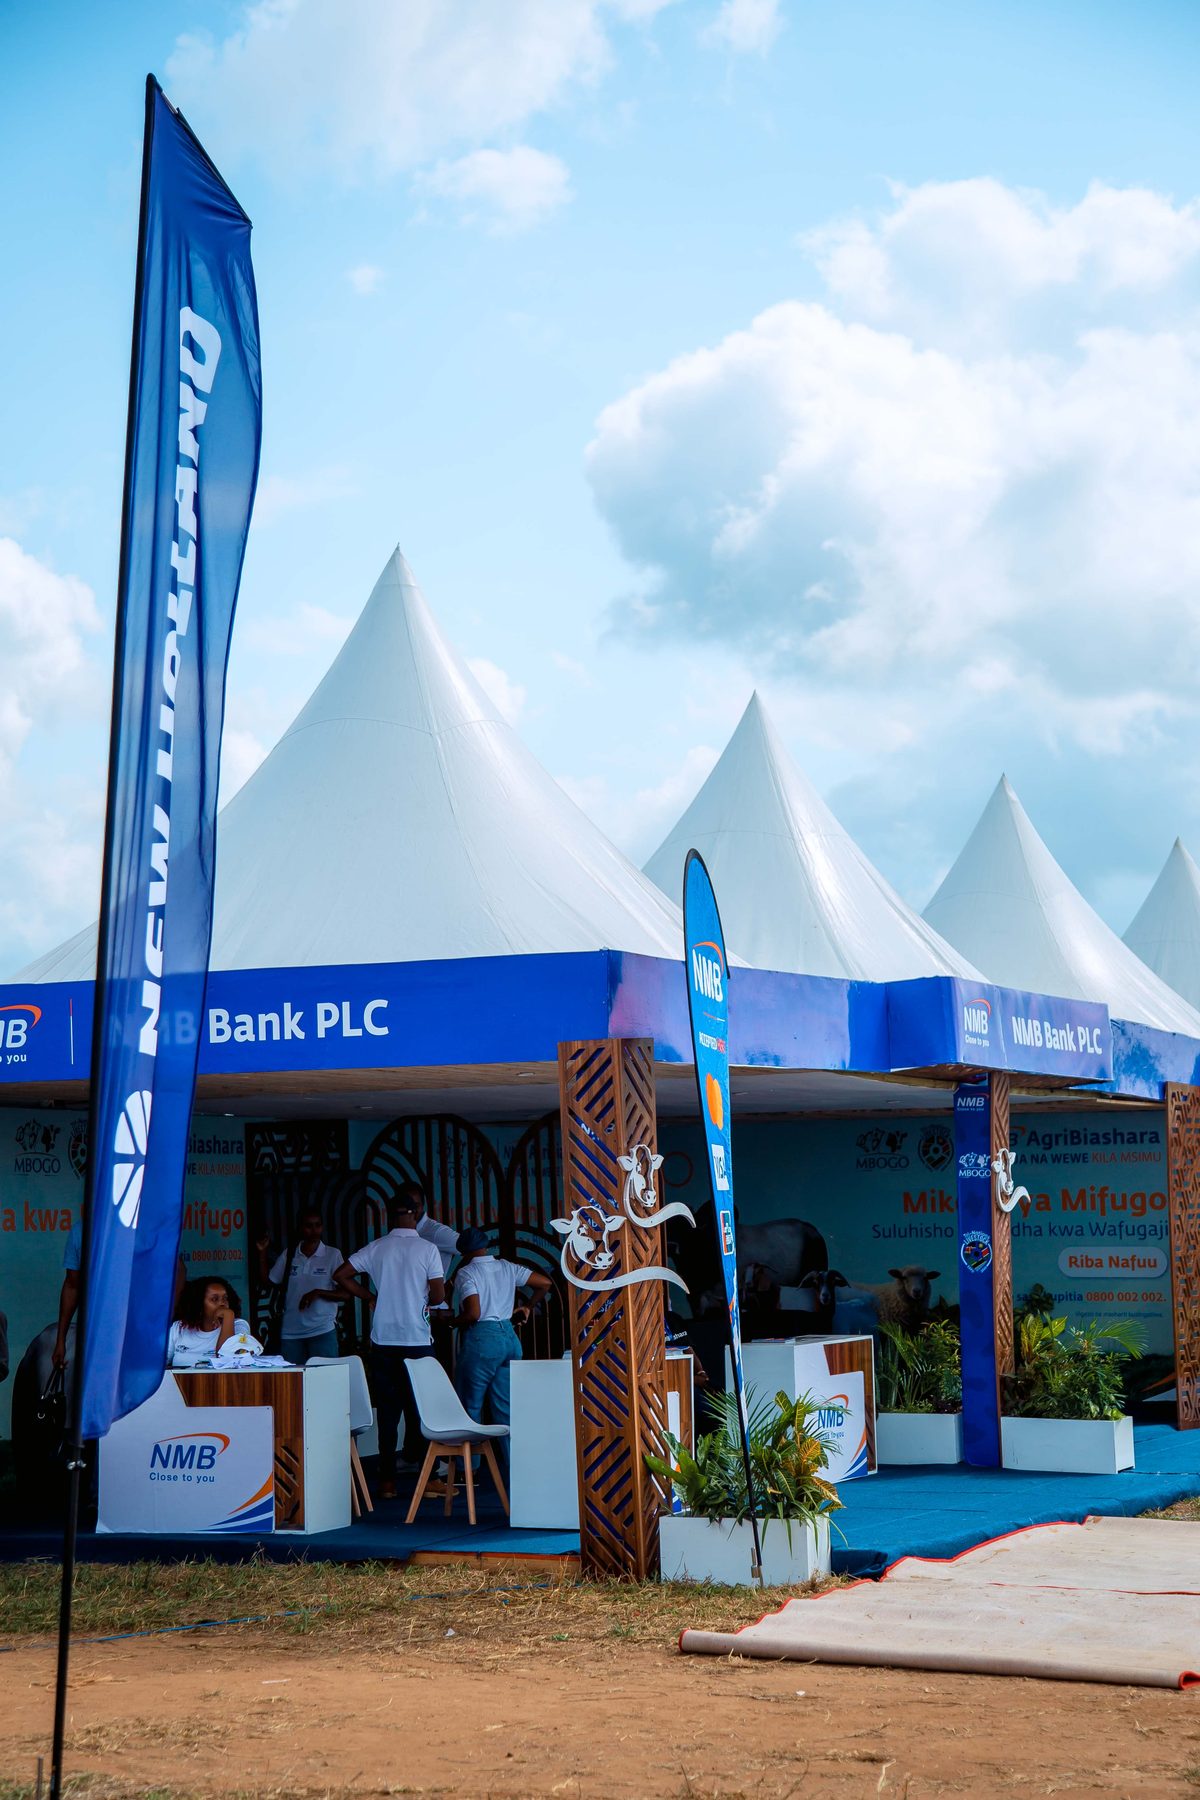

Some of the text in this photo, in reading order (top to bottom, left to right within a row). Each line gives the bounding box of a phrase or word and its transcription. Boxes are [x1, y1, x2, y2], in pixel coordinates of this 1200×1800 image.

[692, 948, 724, 1003] NMB
[207, 1002, 306, 1044] Bank
[316, 998, 390, 1039] PLC
[963, 1006, 989, 1035] NMB
[1011, 1016, 1103, 1055] NMB Bank PLC
[6, 1053, 27, 1065] you
[957, 1096, 985, 1107] NMB
[187, 1133, 244, 1155] iashara
[1026, 1127, 1160, 1151] AgriBiashara
[14, 1157, 61, 1174] MBOGO
[855, 1156, 910, 1169] MBOGO
[1030, 1153, 1049, 1165] NA
[1051, 1152, 1089, 1164] WEWE
[1091, 1151, 1118, 1164] KILA
[1120, 1151, 1162, 1163] MSIMU
[958, 1168, 991, 1177] MBOGO
[902, 1189, 957, 1214] Mik
[1060, 1185, 1168, 1216] Mifugo
[23, 1200, 73, 1232] kwa
[871, 1219, 1168, 1241] Suluhisho dha kwa Wafugaji
[1067, 1254, 1158, 1271] Riba Nafuu
[1085, 1291, 1114, 1303] 0800
[1117, 1291, 1139, 1302] 002
[1141, 1291, 1167, 1302] 002.
[817, 1405, 845, 1429] NMB
[150, 1443, 217, 1470] NMB
[149, 1472, 215, 1484] Close to you
